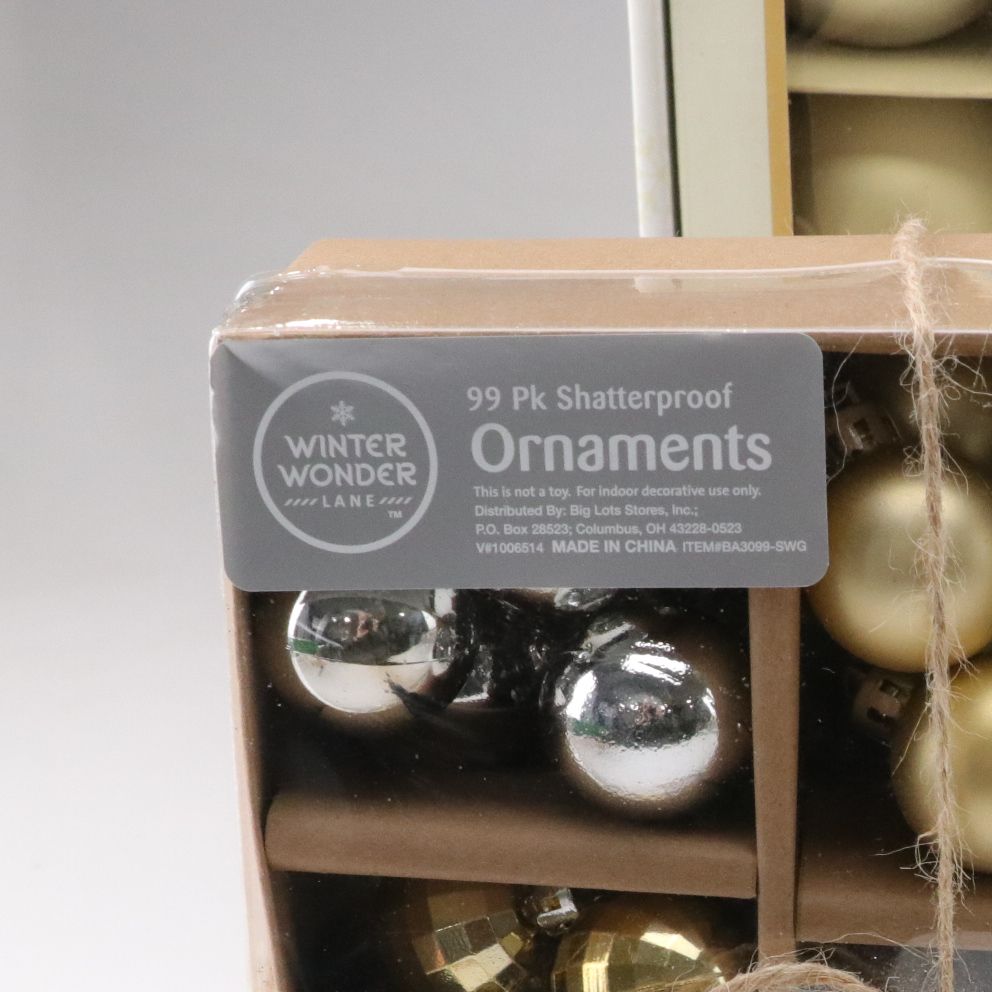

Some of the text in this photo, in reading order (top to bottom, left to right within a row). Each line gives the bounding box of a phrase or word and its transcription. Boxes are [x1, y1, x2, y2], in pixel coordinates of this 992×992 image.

[466, 382, 733, 416] 99 Pk Shatterproof
[284, 433, 407, 459] WINTER
[471, 422, 773, 473] Ornaments
[276, 462, 417, 488] WONDER
[473, 484, 762, 500] This is not a toy. For indoor decorative use only.
[321, 494, 375, 508] LANE
[474, 504, 543, 517] Distributed
[546, 504, 567, 519] By:
[570, 504, 590, 518] Big
[594, 504, 621, 516] Lots
[624, 504, 669, 517] Stores,
[475, 523, 500, 535] P.O.
[503, 523, 527, 535] Box
[575, 523, 643, 536] Columbus,
[646, 523, 666, 535] OH
[669, 522, 743, 535] 43228-0523
[552, 540, 600, 554] MADE
[604, 540, 621, 553] IN
[624, 539, 677, 553] CHINA
